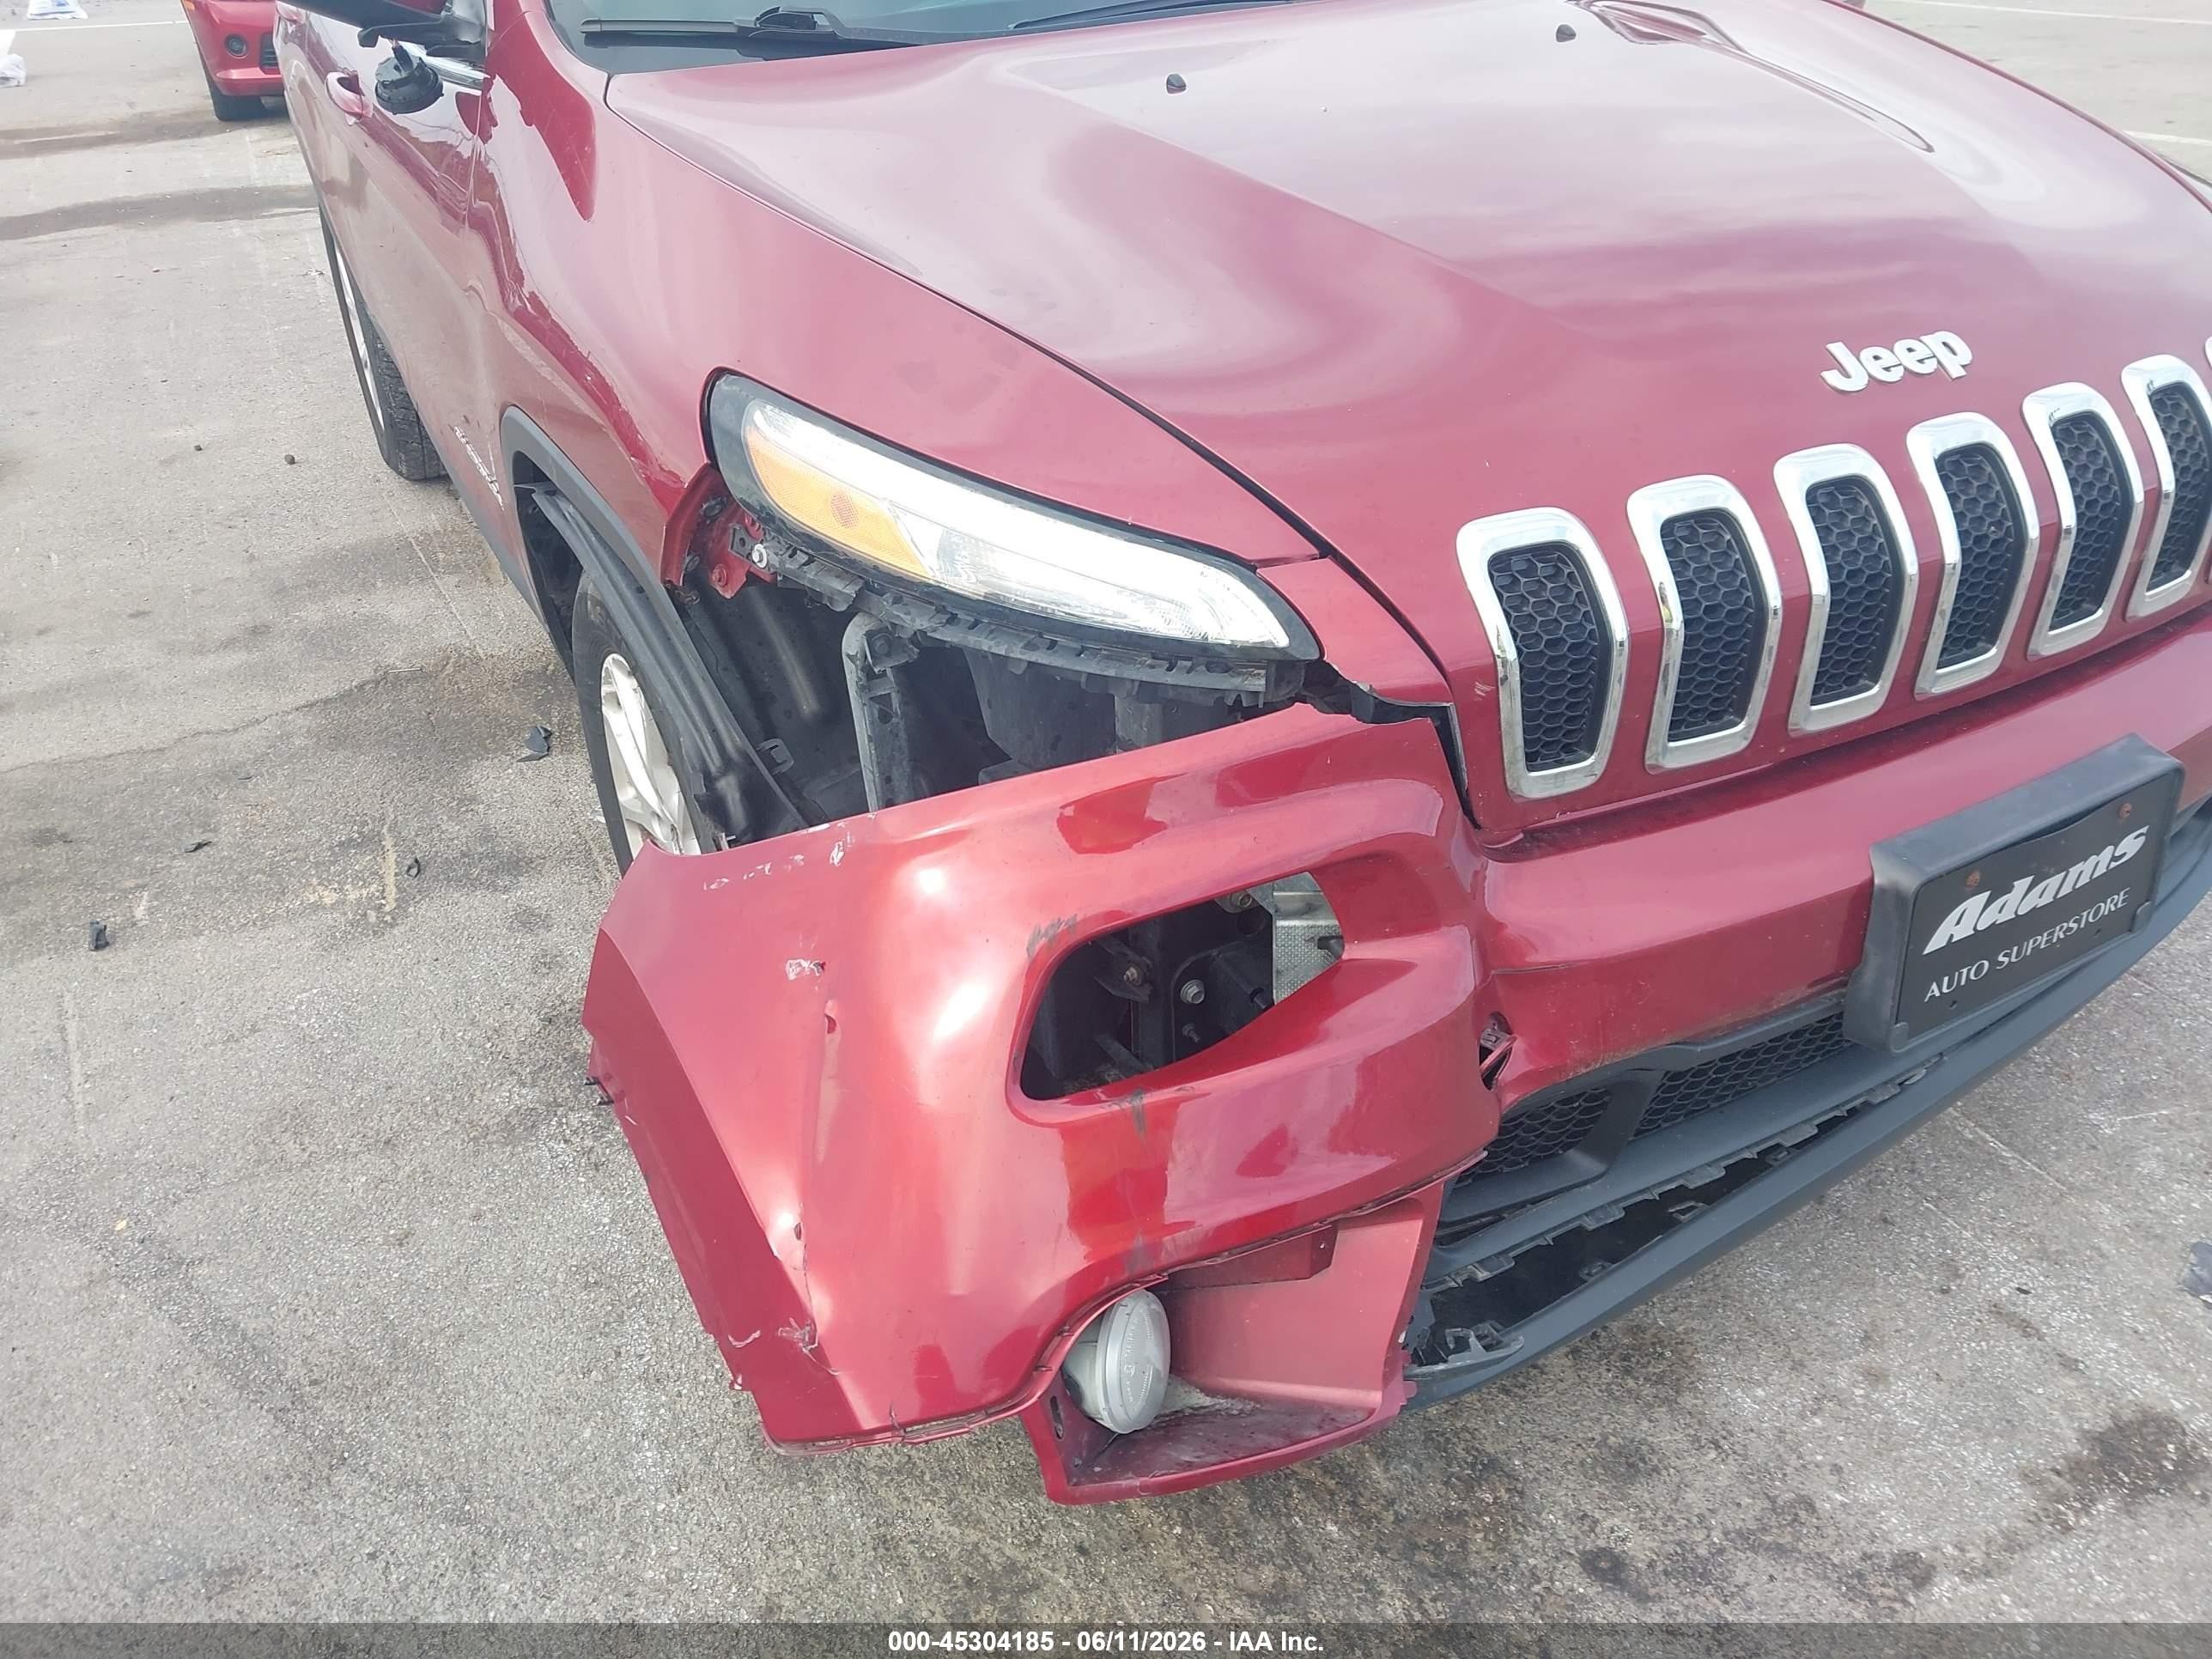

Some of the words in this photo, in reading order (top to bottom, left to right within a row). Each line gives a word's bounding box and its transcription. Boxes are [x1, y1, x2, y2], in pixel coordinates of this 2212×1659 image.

[1820, 330, 1973, 392] Jeep
[1922, 825, 2150, 956] Adams
[1923, 959, 1990, 1003] AUTO
[1996, 886, 2132, 970] SUPERSTORE
